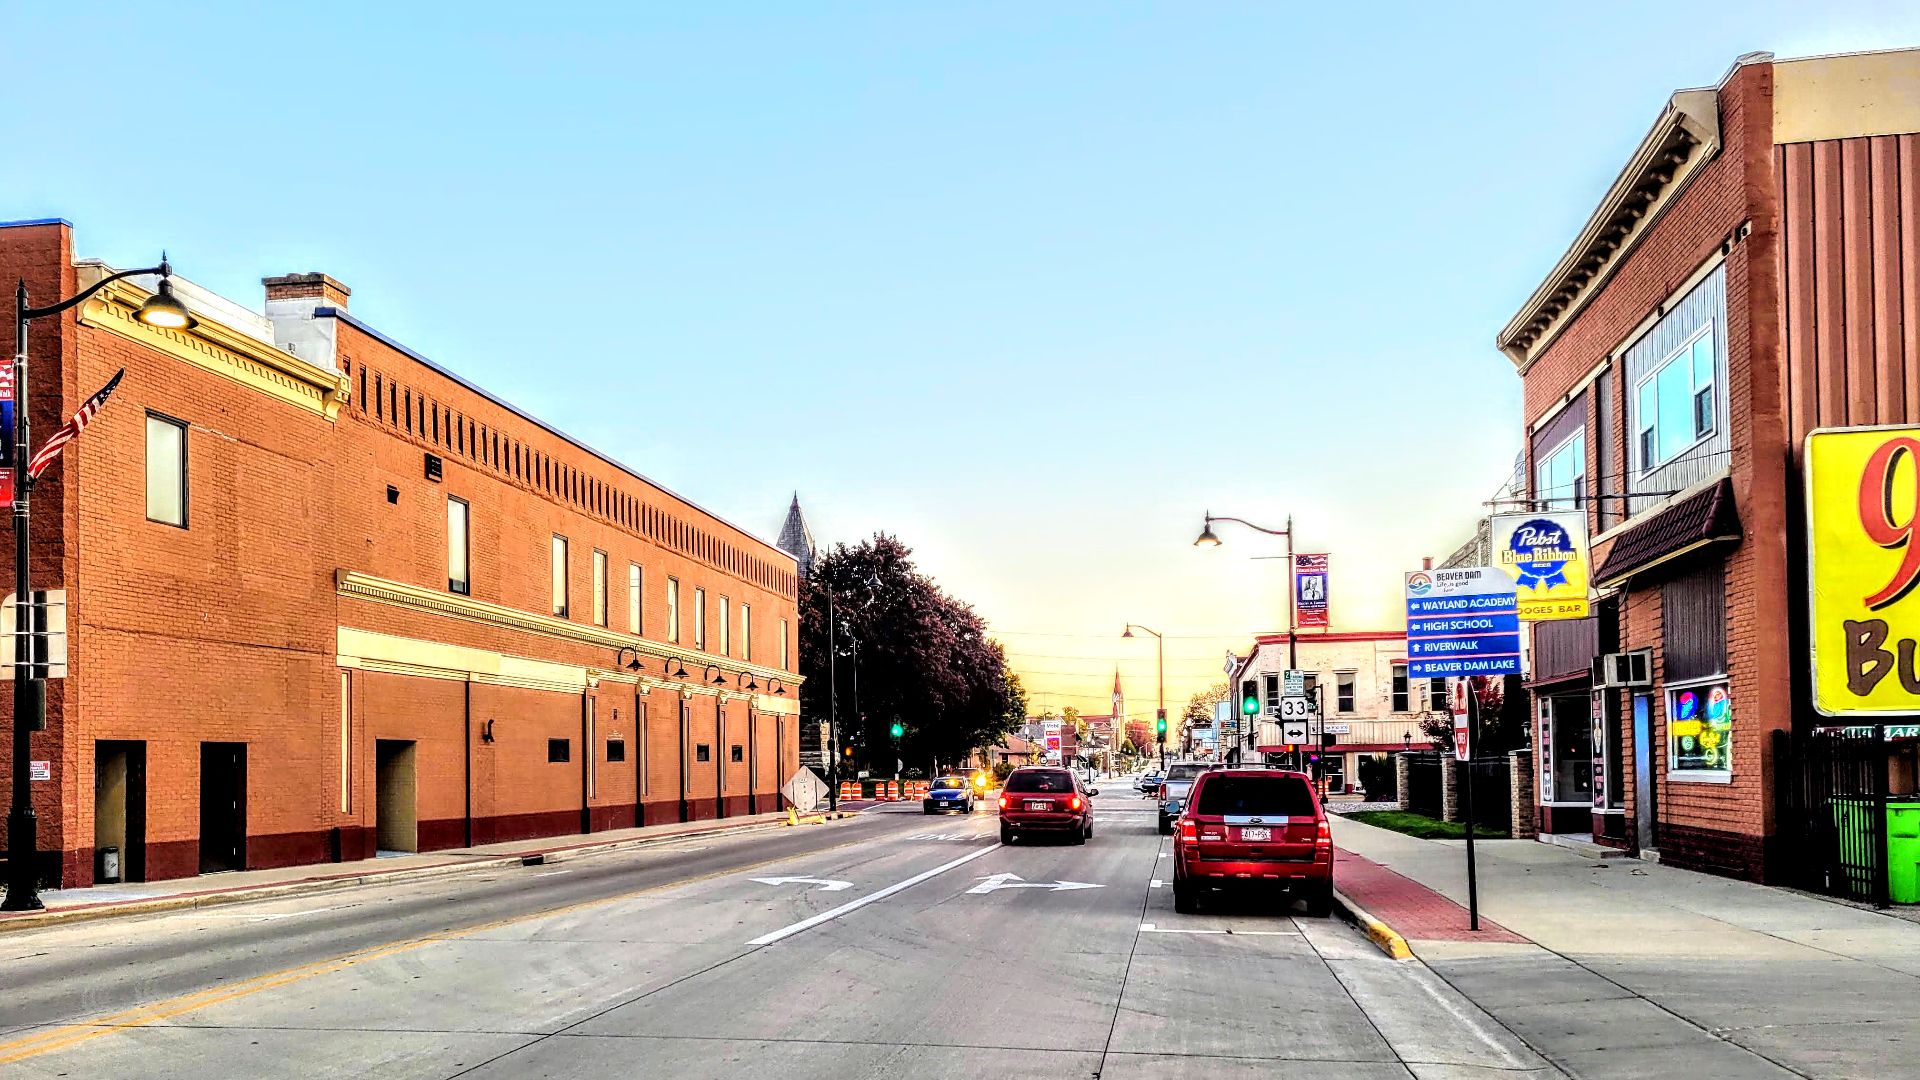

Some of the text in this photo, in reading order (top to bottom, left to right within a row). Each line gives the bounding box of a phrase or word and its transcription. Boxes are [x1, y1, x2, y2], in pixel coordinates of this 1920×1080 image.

[1517, 526, 1562, 546] Pabst
[1502, 547, 1578, 564] Blue Ribbon
[1436, 570, 1482, 581] BEAVER DAM
[1422, 597, 1517, 611] WAYLAND ACADEMY
[1559, 604, 1582, 613] BAR
[1423, 619, 1494, 631] HIGH SCHOOL
[1424, 641, 1479, 652] RIVERWALK
[1425, 659, 1515, 672] BEAVER DAM LAKE
[1284, 701, 1306, 715] 33
